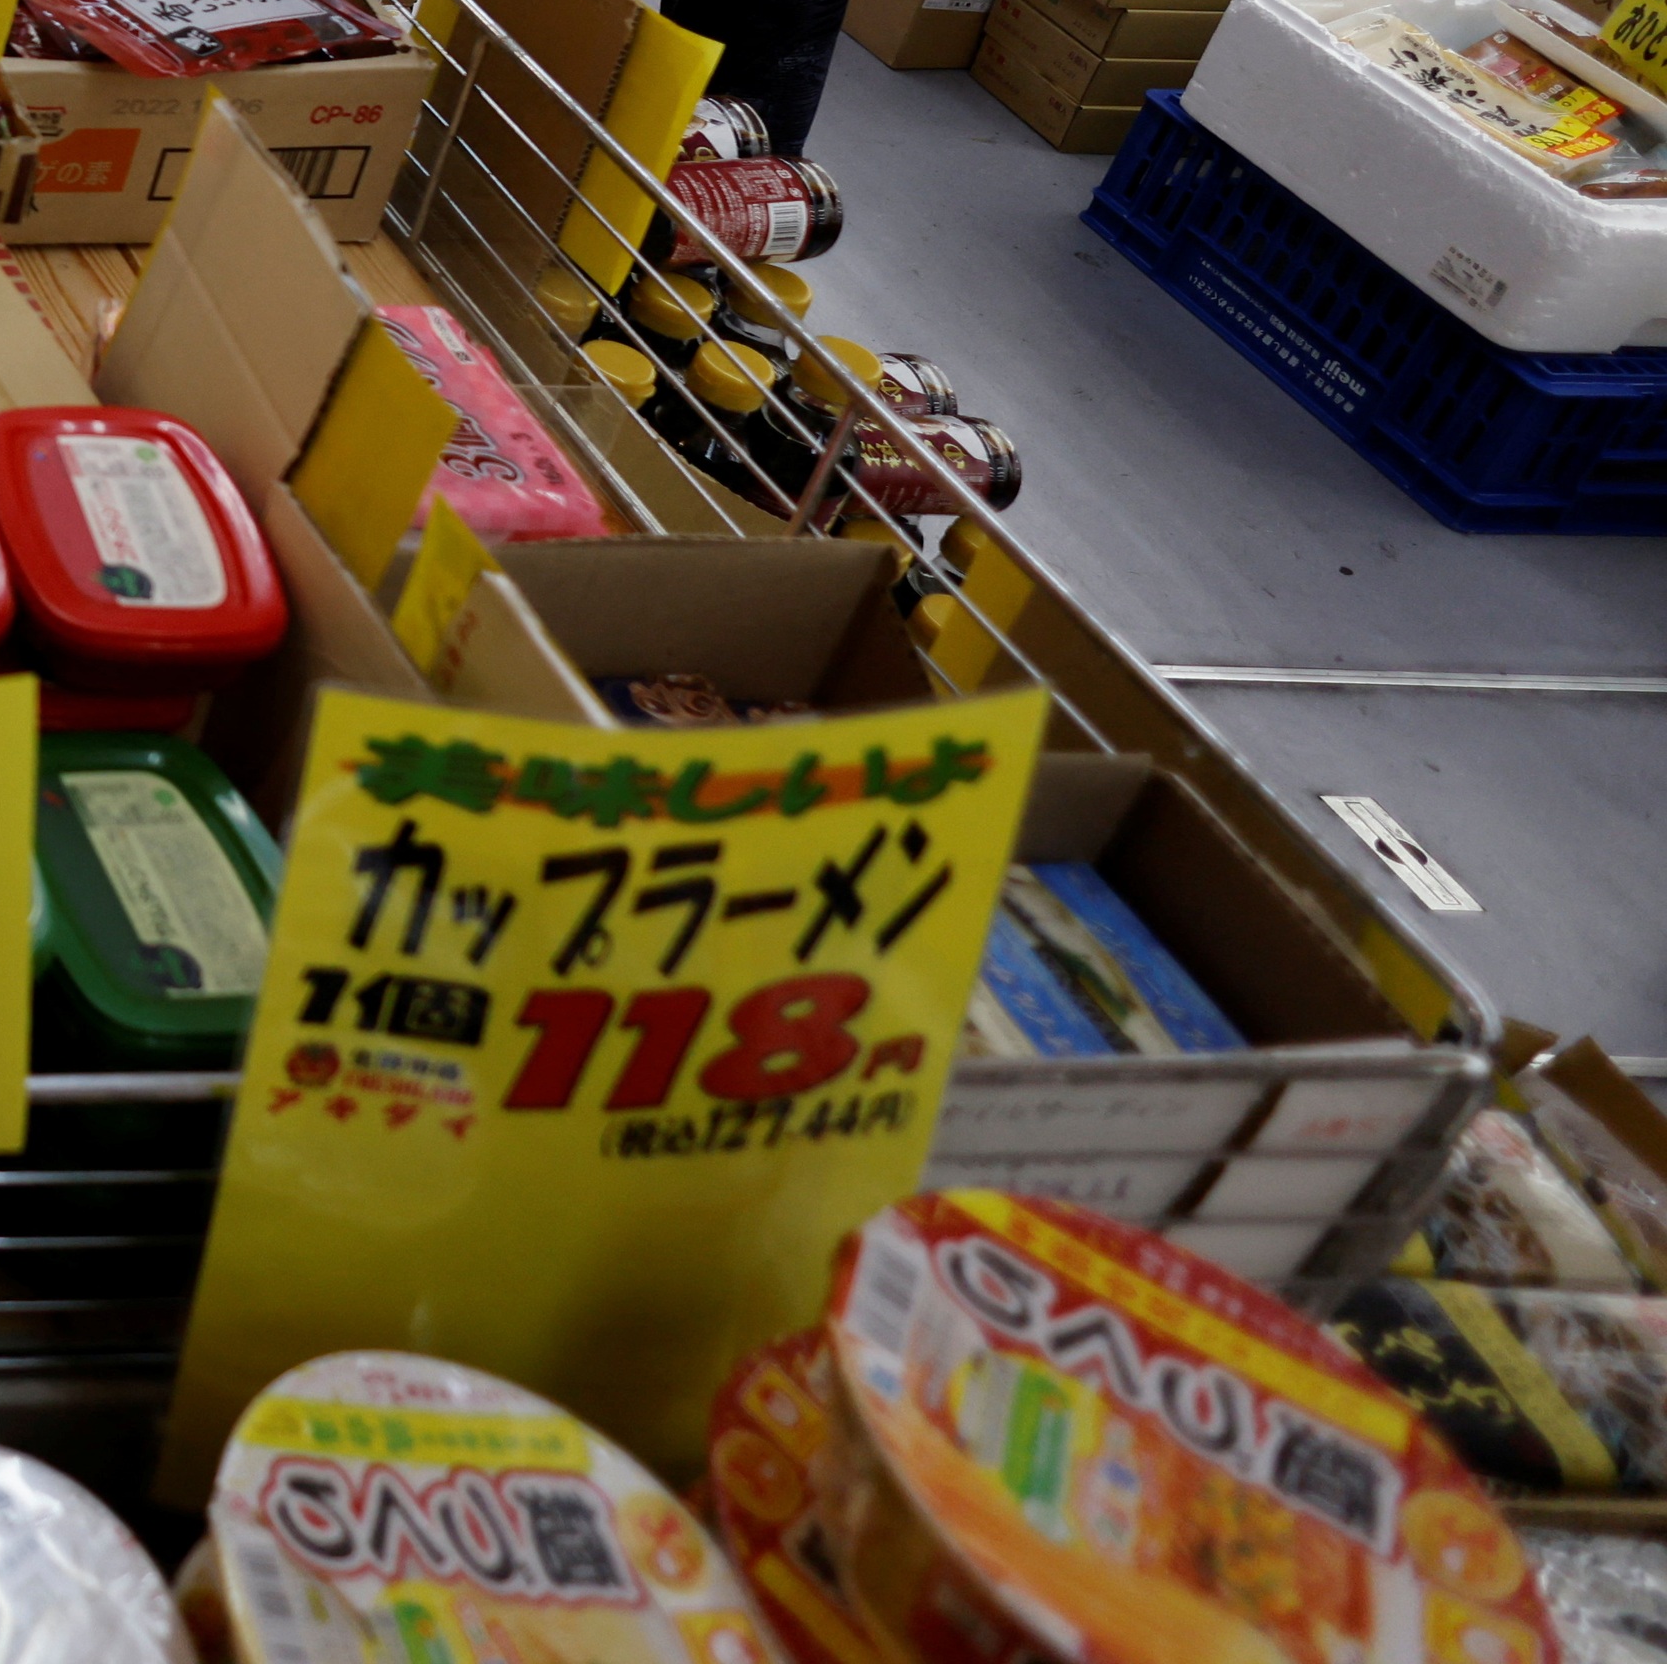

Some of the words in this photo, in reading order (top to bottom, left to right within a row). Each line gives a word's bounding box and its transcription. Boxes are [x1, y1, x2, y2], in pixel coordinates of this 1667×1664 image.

[310, 105, 383, 125] CP-86
[349, 820, 951, 975] カップラーメン
[299, 966, 493, 1046] 1個
[504, 974, 871, 1110] 118
[865, 1036, 925, 1081] 円
